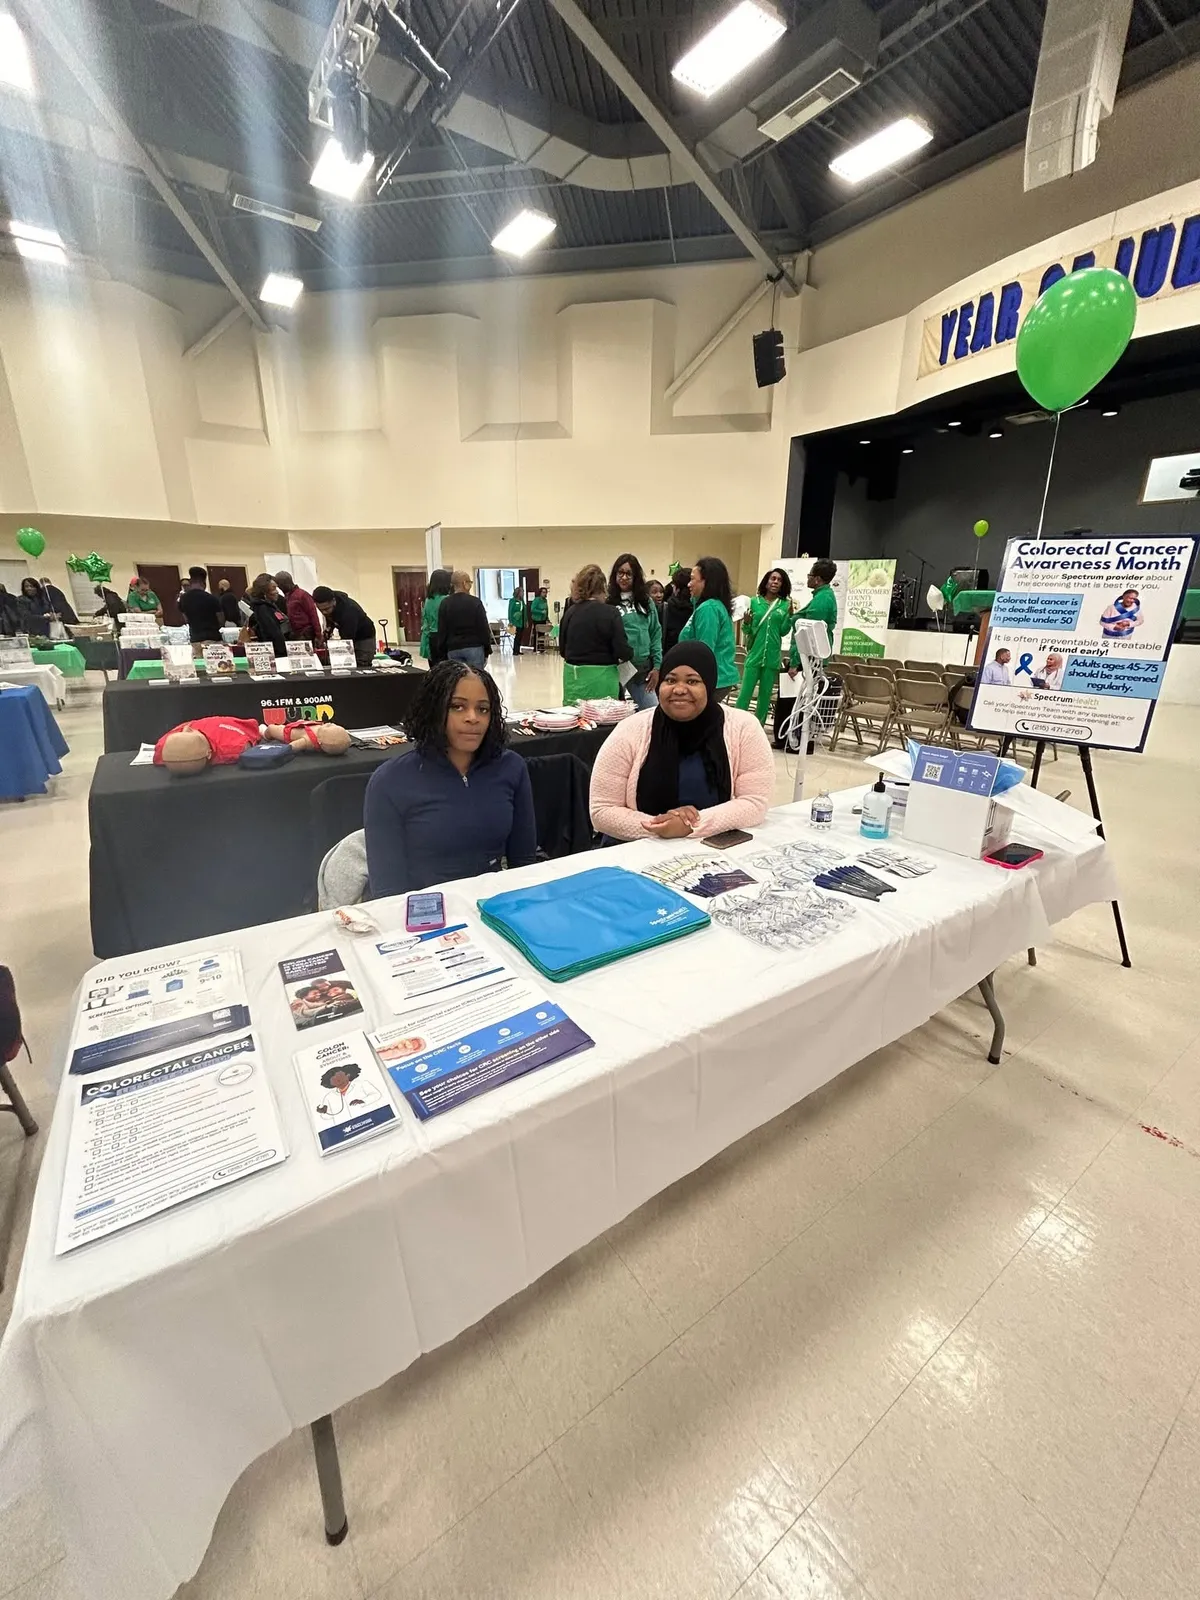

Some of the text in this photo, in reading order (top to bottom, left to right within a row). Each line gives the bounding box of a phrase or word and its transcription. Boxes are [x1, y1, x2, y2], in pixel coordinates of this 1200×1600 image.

[938, 281, 1023, 366] YEAR
[1018, 541, 1188, 556] Colorectal Cancer
[1010, 556, 1181, 570] Awareness Month
[1061, 573, 1104, 582] Spectrum
[1105, 573, 1144, 582] provider
[1032, 581, 1071, 589] screening
[997, 595, 1040, 605] Colorectal
[1070, 598, 1079, 606] is
[1008, 605, 1047, 614] deadliest
[1002, 614, 1032, 624] people
[1032, 616, 1059, 624] under
[1060, 616, 1073, 625] 50
[1003, 635, 1011, 643] is
[1013, 635, 1038, 644] often
[1040, 638, 1099, 649] preventable
[1113, 641, 1162, 651] treatable
[1038, 644, 1109, 657] if found early!
[1070, 658, 1101, 669] Adults
[1101, 662, 1125, 672] ages
[1067, 670, 1159, 684] should be screened
[1086, 681, 1134, 693] regularly.
[260, 695, 333, 707] 96.1FM & 900AM
[1001, 707, 1015, 715] help
[1052, 713, 1075, 721] cancer
[1076, 716, 1109, 726] screening
[1010, 702, 1041, 711] Spectrum
[1061, 707, 1077, 715] with
[1077, 709, 1090, 717] any
[1091, 711, 1126, 721] questions
[95, 975, 115, 984] DID
[118, 970, 141, 979] YOU
[143, 960, 181, 975] KNOW?
[317, 1041, 345, 1055] COLON
[395, 1061, 415, 1071] Focus
[446, 1041, 462, 1050] facts
[419, 1087, 432, 1097] See
[431, 1081, 446, 1092] your
[446, 1071, 469, 1083] choices
[469, 1066, 479, 1074] for
[478, 1061, 493, 1069] CRC
[492, 1048, 519, 1063] screening
[535, 1034, 549, 1043] other
[549, 1028, 560, 1037] side
[86, 1061, 190, 1096] COLORECTAL
[191, 1039, 250, 1064] CANCER
